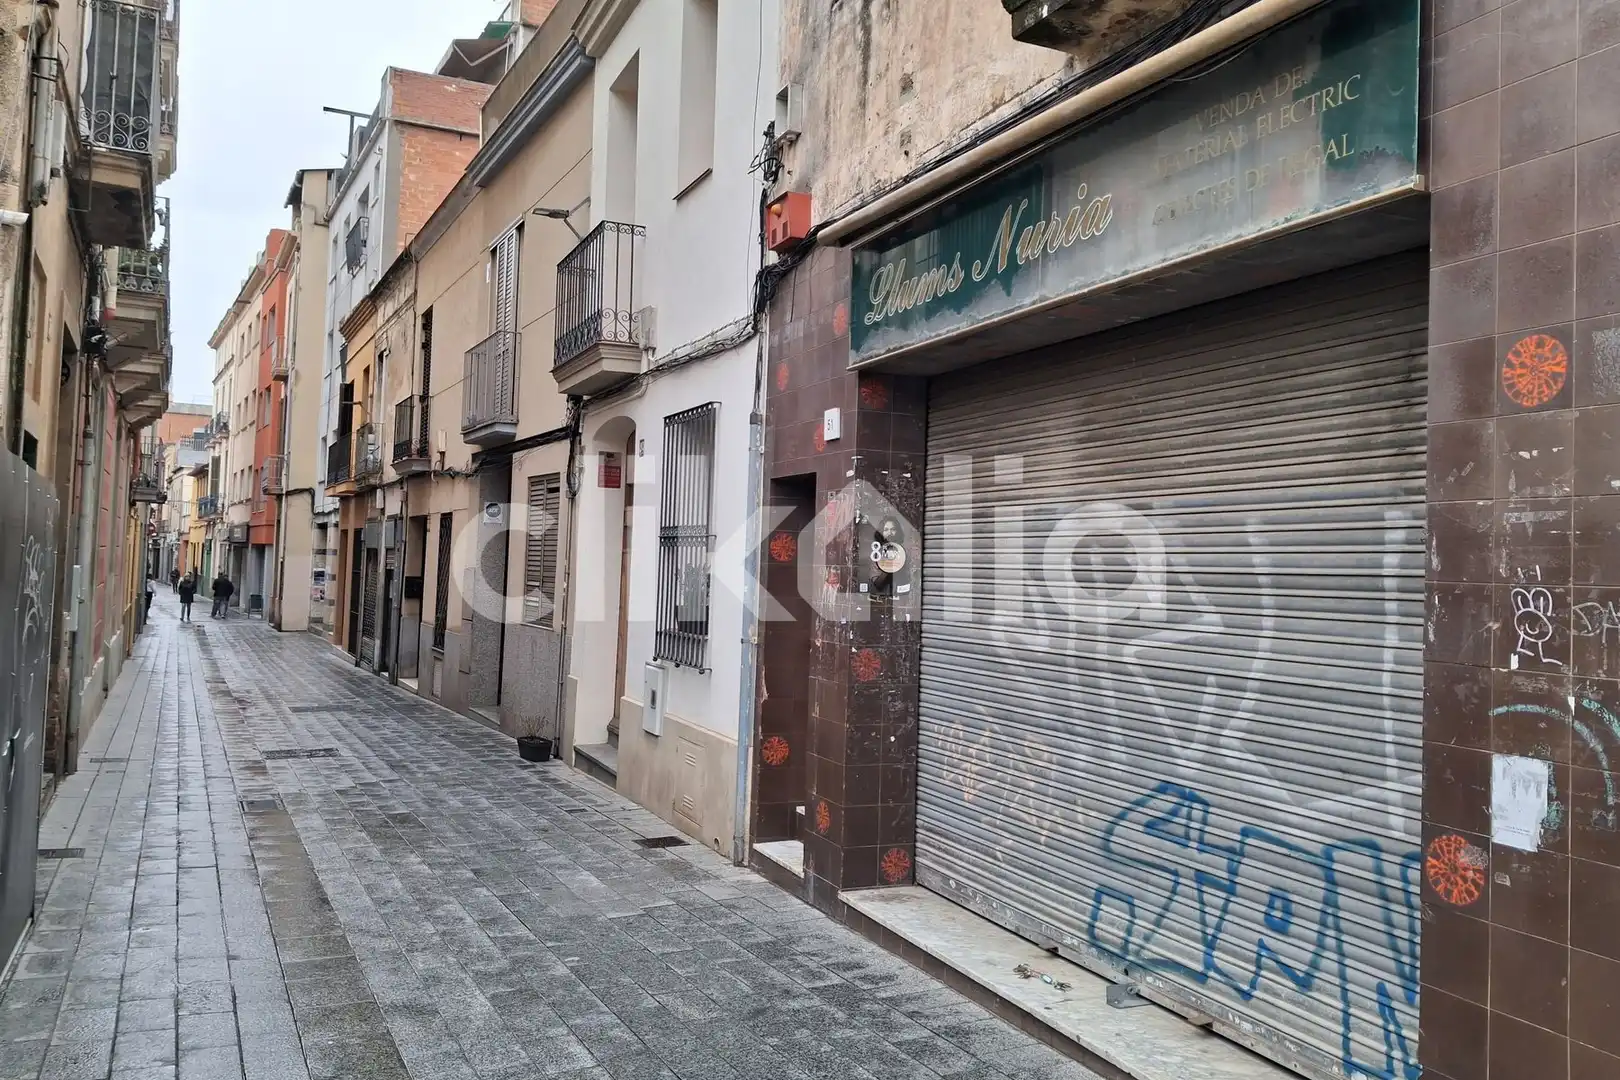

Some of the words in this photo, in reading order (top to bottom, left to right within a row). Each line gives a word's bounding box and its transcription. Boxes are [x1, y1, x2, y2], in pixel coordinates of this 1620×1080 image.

[1195, 86, 1267, 131] VENDA
[1244, 163, 1271, 192] DE
[864, 252, 965, 325] Llums
[971, 183, 1113, 282] Nuria
